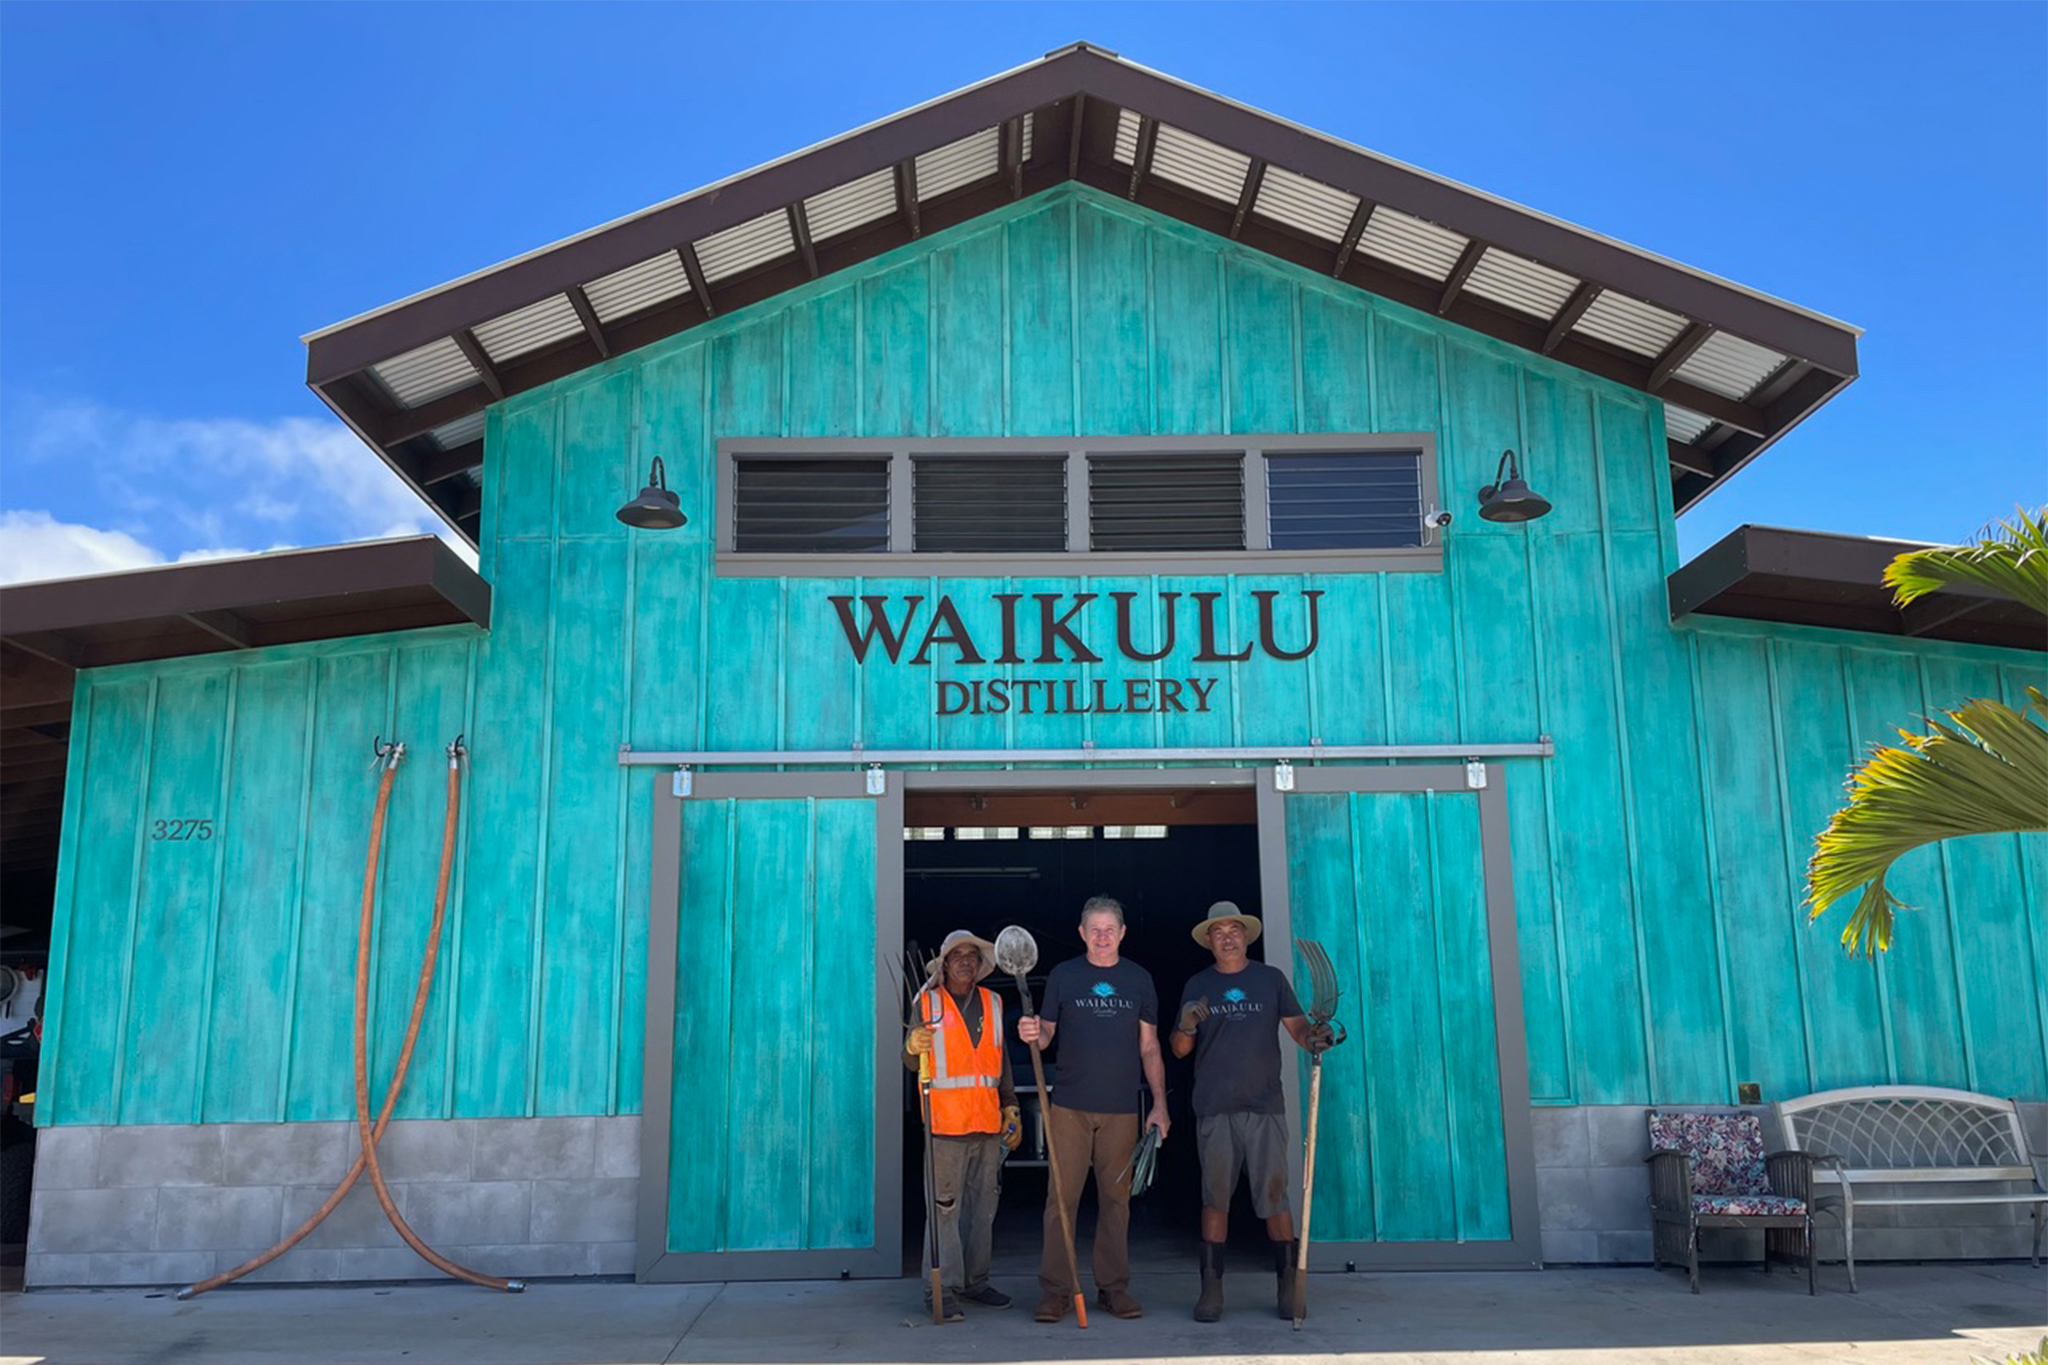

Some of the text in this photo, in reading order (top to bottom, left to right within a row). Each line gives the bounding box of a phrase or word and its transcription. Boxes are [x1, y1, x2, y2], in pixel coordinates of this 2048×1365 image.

[828, 591, 1325, 664] WAIKULU
[936, 678, 1218, 715] DISTILLERY
[152, 819, 212, 841] 3275
[1075, 998, 1134, 1009] WAIKULU
[1210, 1003, 1263, 1015] WAIKULU
